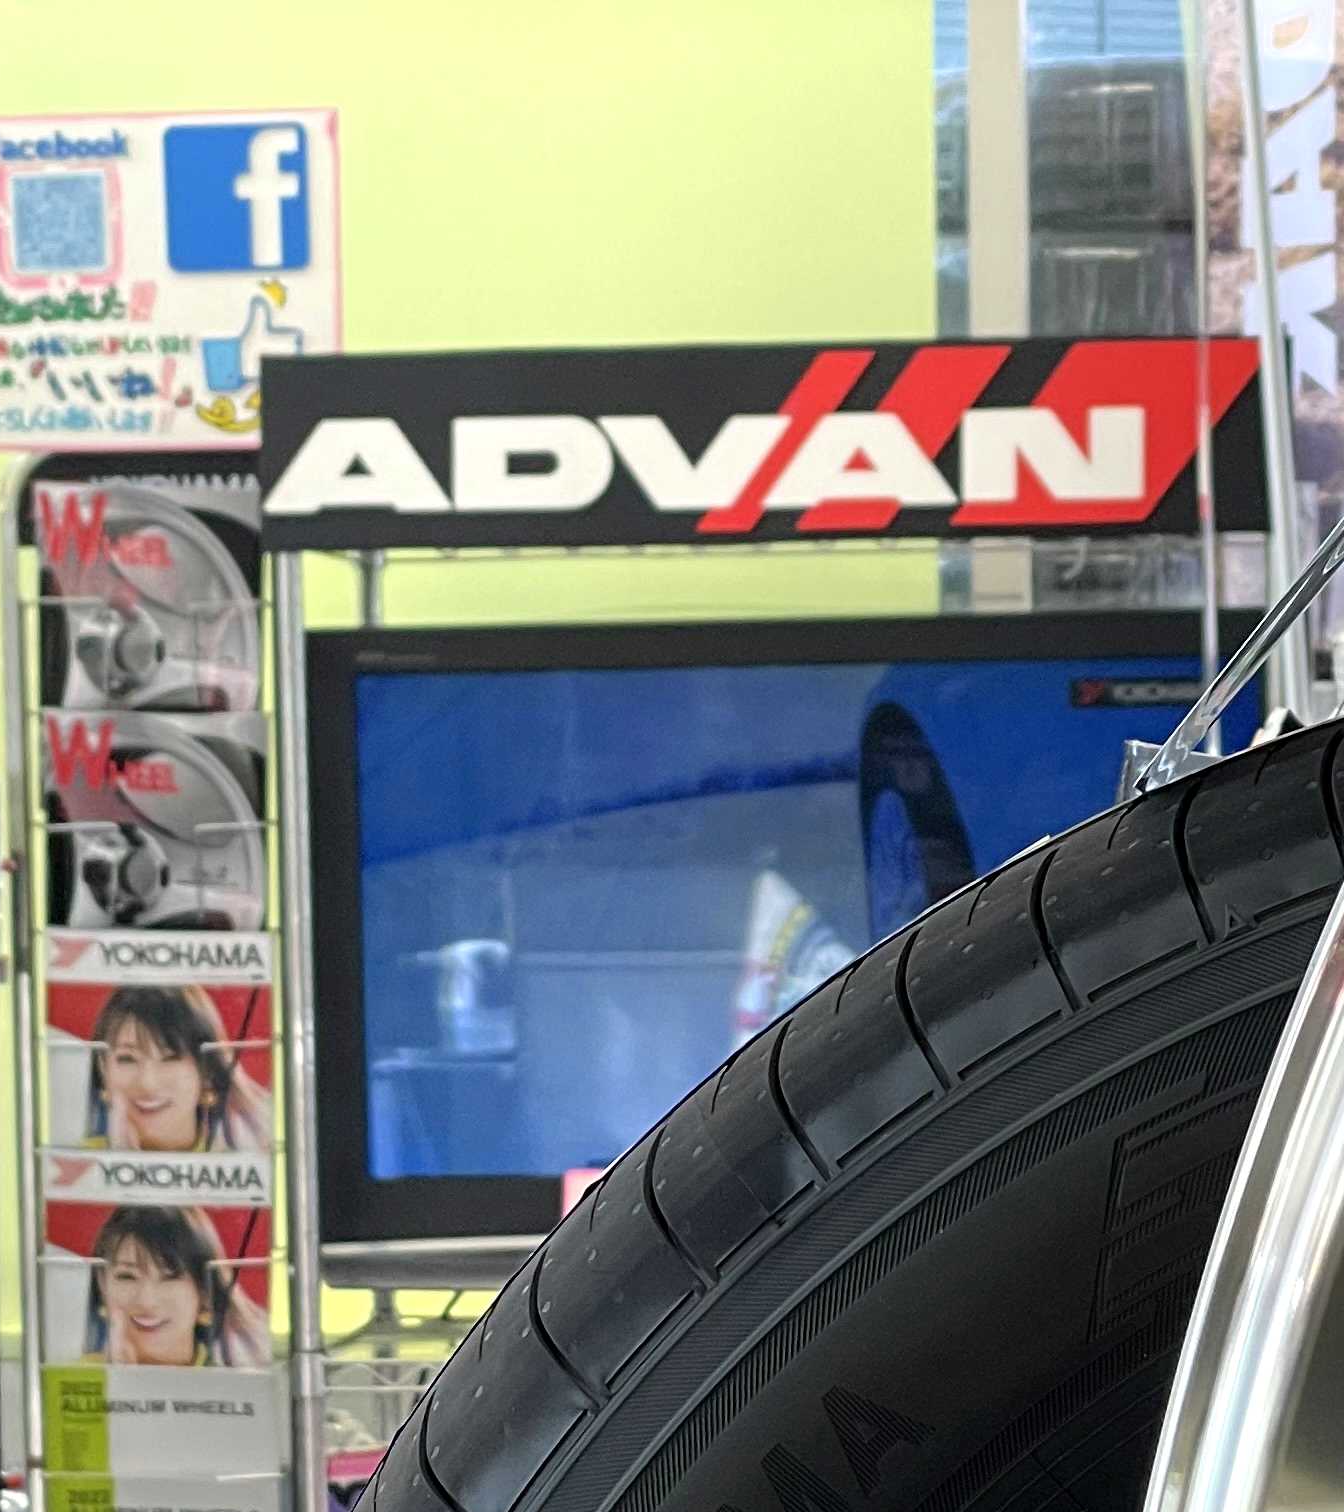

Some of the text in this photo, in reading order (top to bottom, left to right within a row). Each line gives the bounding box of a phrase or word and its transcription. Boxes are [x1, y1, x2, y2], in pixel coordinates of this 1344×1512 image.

[262, 406, 1145, 515] ADVAN
[100, 941, 263, 969] YOKOHAMA
[100, 1161, 263, 1190] YOKOHAMA
[174, 1400, 255, 1417] WHEELS
